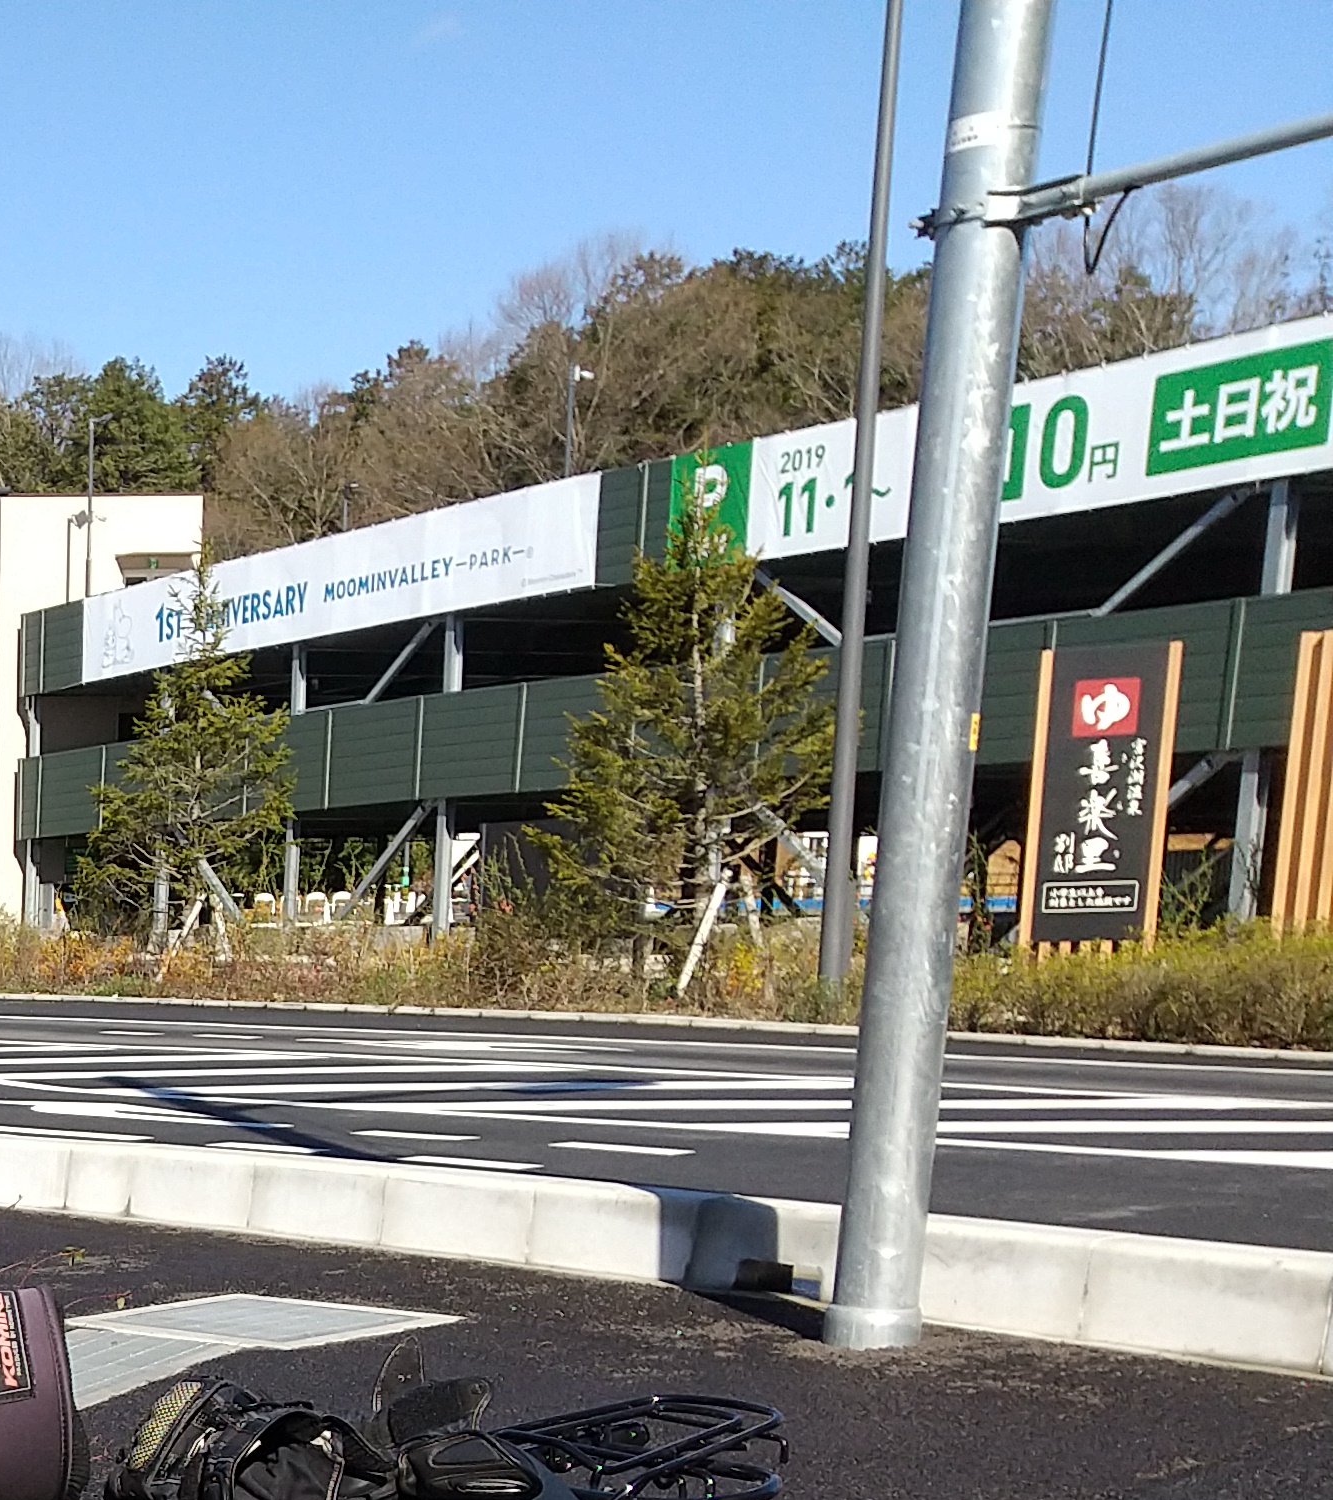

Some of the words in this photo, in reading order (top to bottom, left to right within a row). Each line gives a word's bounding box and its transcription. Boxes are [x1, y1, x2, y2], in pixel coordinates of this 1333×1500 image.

[1160, 364, 1319, 453] 土日祝
[780, 444, 826, 474] 2019
[155, 603, 184, 643] 1ST
[191, 581, 309, 636] IVERSARY
[1080, 682, 1131, 731] ゆ
